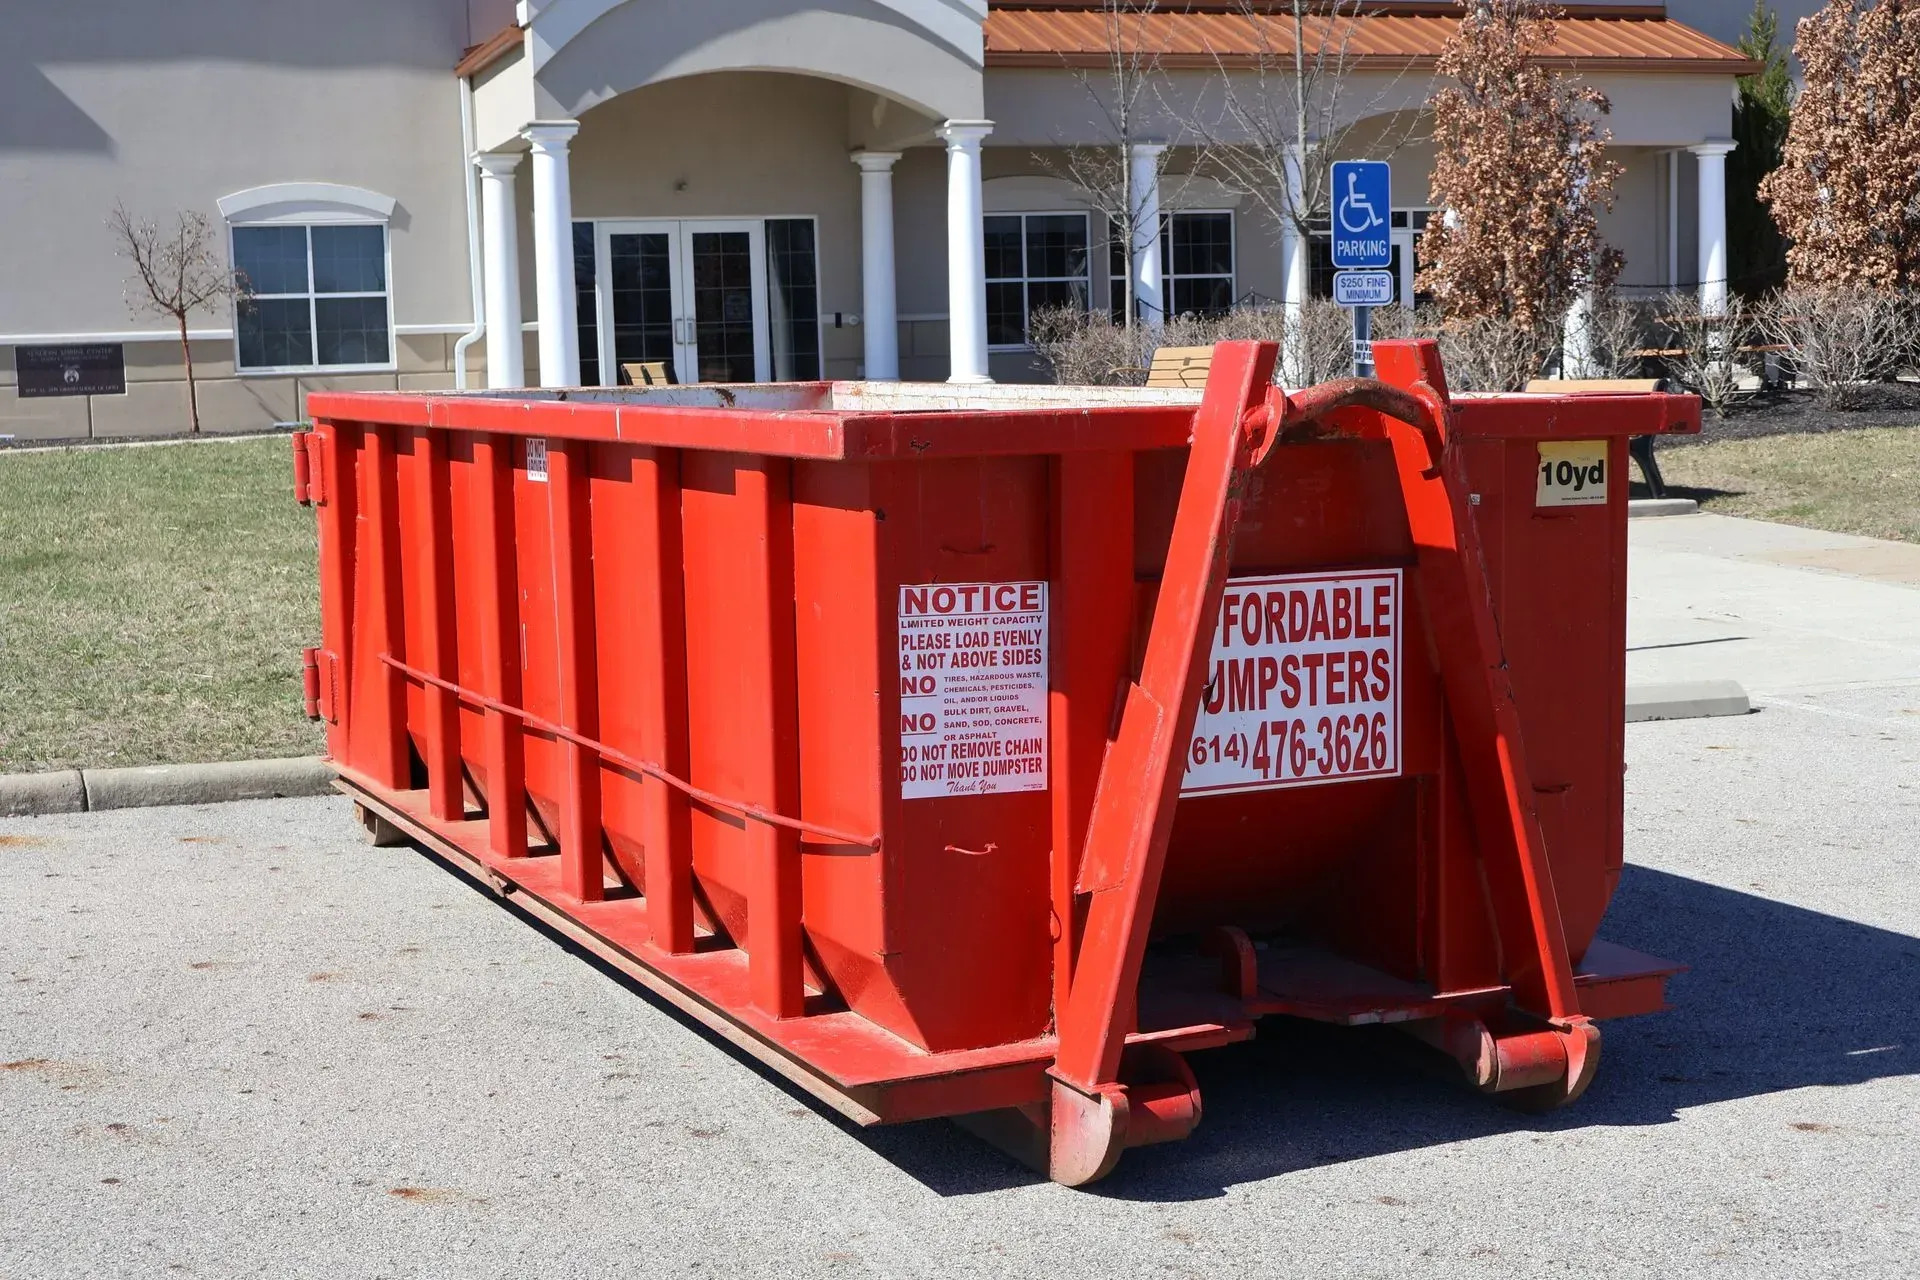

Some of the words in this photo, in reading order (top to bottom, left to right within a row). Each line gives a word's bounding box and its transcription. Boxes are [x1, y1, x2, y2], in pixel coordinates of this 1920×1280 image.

[1337, 240, 1387, 257] PARKING
[1340, 277, 1363, 288] $250
[1366, 278, 1386, 288] FINE
[1345, 289, 1381, 300] MINIMUM
[1542, 459, 1604, 492] 10yd
[904, 584, 1039, 614] NOTICE
[901, 619, 944, 629] LIMITED
[947, 617, 989, 627] WEIGHT
[992, 615, 1042, 625] CAPACITY
[1217, 585, 1391, 648] FORDABLE
[901, 633, 951, 651] PLEASE
[956, 631, 989, 649] LOAD
[994, 629, 1042, 647] EVENLY
[901, 654, 912, 671] &
[917, 653, 946, 670] NOT
[950, 650, 998, 669] ABOVE
[1002, 648, 1042, 666] SIDES
[901, 675, 936, 695] NO
[944, 675, 968, 683] TIRES,
[969, 673, 1014, 681] HAZARDOUS
[1016, 671, 1043, 679] WASTE,
[1206, 648, 1391, 715] UMPSTERS
[944, 685, 988, 693] CHEMICALS,
[990, 683, 1035, 691] PESTICIDES,
[990, 694, 1019, 702] LIQUIDS
[944, 708, 967, 716] BULK
[970, 707, 991, 715] DIRT,
[993, 705, 1029, 713] GRAVEL,
[901, 712, 936, 732] NO
[944, 721, 970, 729] SAND,
[995, 716, 1042, 726] CONCRETE,
[958, 732, 997, 740] ASPHALT
[901, 746, 917, 762] DO
[922, 744, 947, 761] NOT
[951, 741, 1001, 760] REMOVE
[1005, 738, 1042, 756] CHAIN
[1252, 712, 1387, 779] 476-3626
[901, 765, 916, 782] DO
[920, 764, 944, 781] NOT
[947, 761, 979, 779] MOVE
[982, 757, 1042, 777] DUMPSTER
[946, 781, 976, 794] Thank
[978, 779, 997, 794] You
